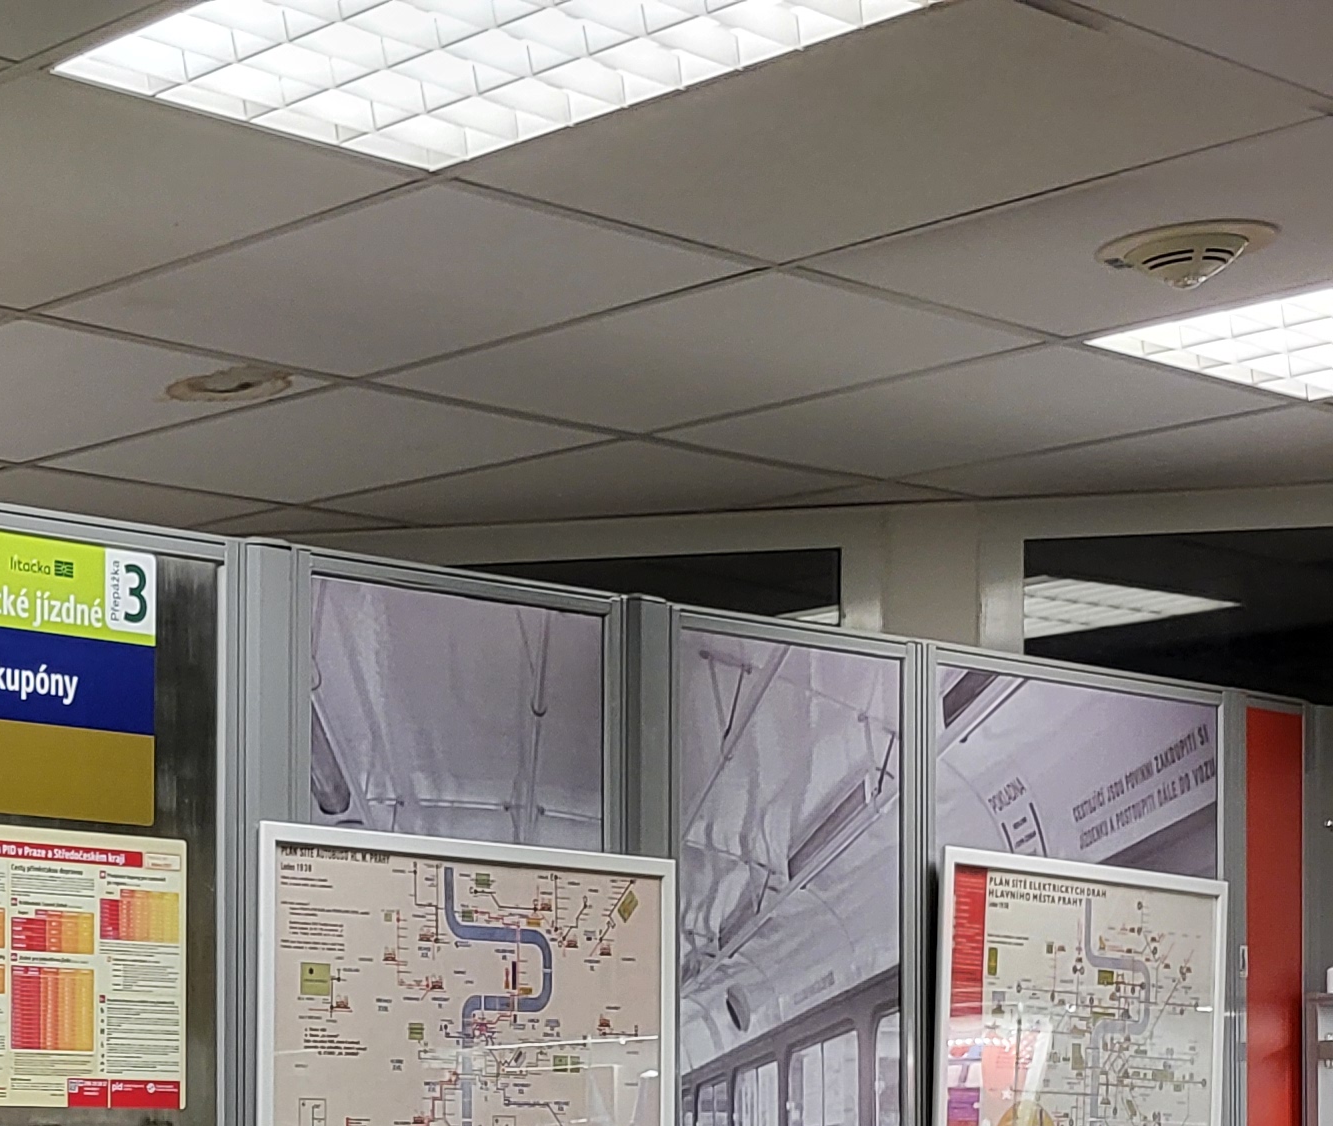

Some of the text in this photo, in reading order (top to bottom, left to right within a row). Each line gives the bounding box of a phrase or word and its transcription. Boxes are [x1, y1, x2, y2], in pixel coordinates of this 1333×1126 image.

[33, 591, 102, 628] jízdné
[110, 561, 120, 622] Přepážka
[124, 564, 147, 623] 3
